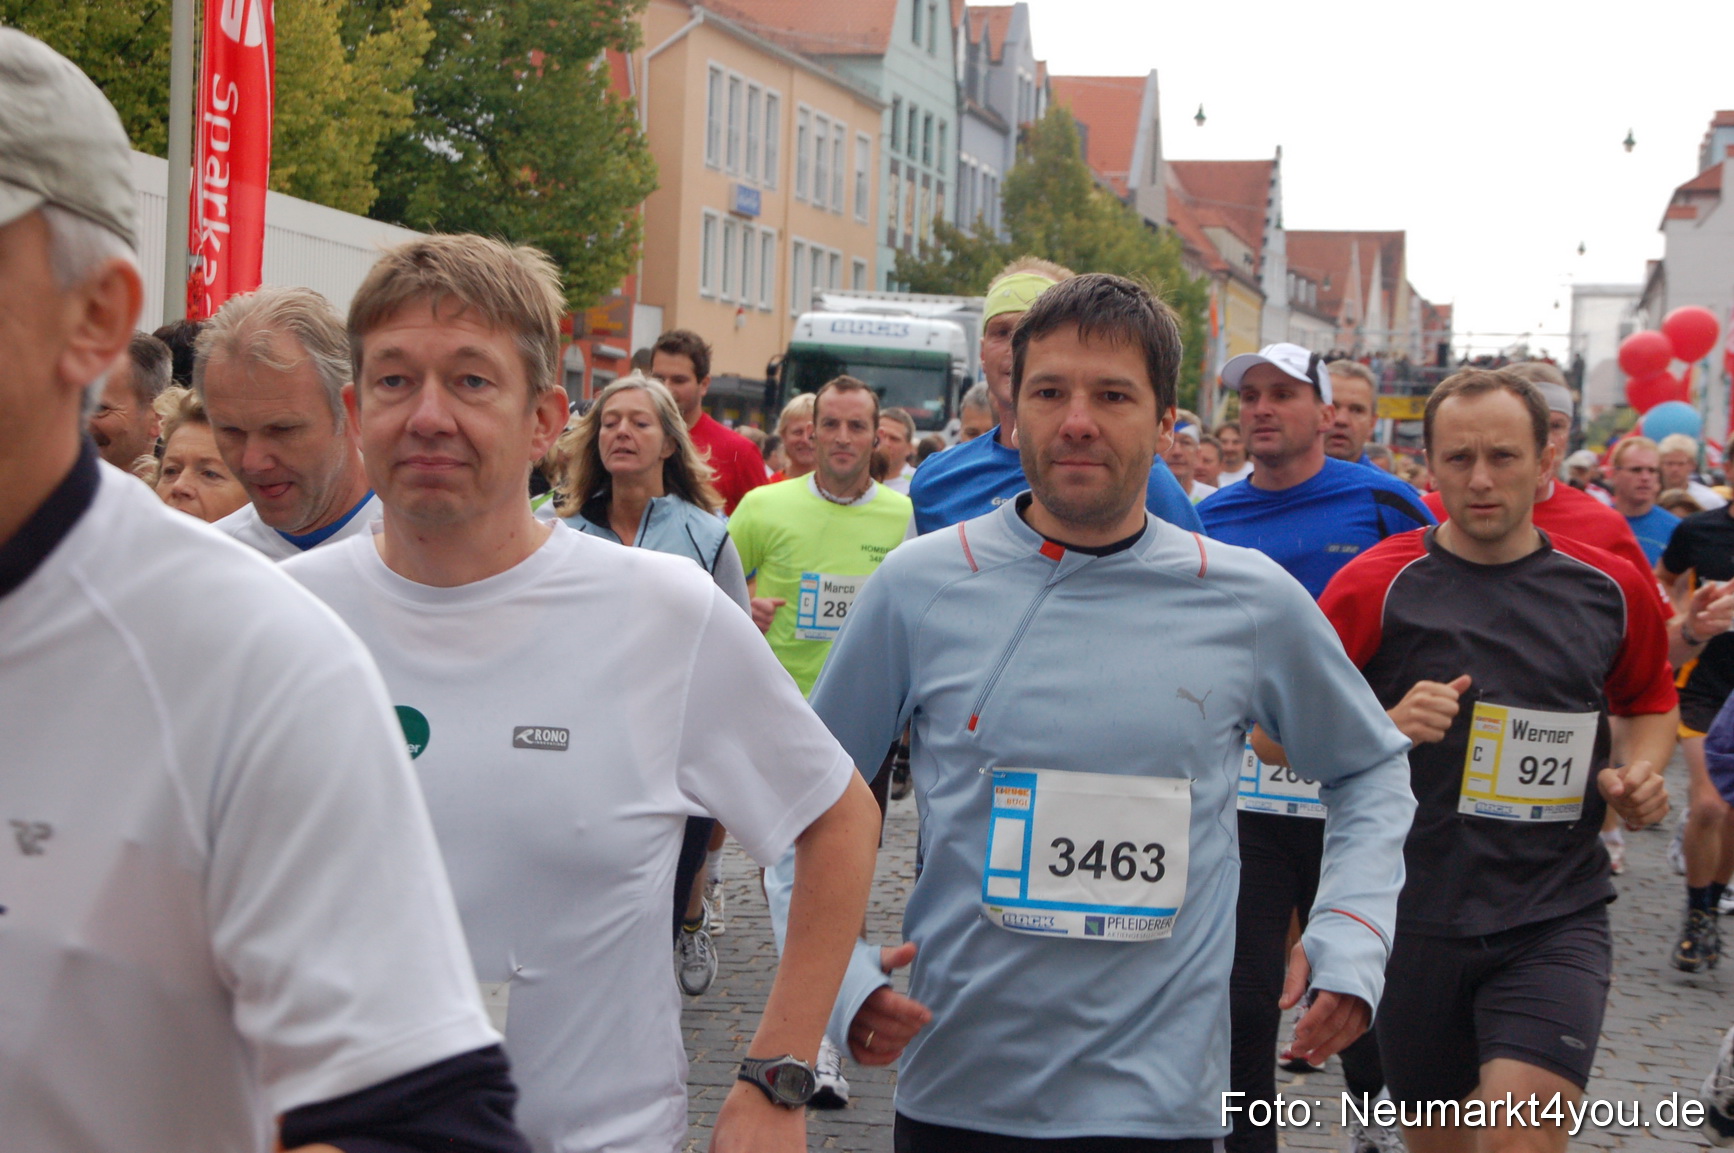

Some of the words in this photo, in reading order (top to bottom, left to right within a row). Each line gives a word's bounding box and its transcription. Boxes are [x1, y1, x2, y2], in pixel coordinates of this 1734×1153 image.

[824, 581, 855, 594] Marco
[804, 597, 810, 607] C
[823, 600, 854, 618] 28
[534, 728, 568, 743] RONO
[1512, 718, 1574, 744] Werner
[1247, 755, 1254, 767] B
[1472, 746, 1483, 762] C
[1518, 755, 1573, 786] 921
[1048, 837, 1166, 883] 3463
[1107, 916, 1173, 931] PFLEIDERER
